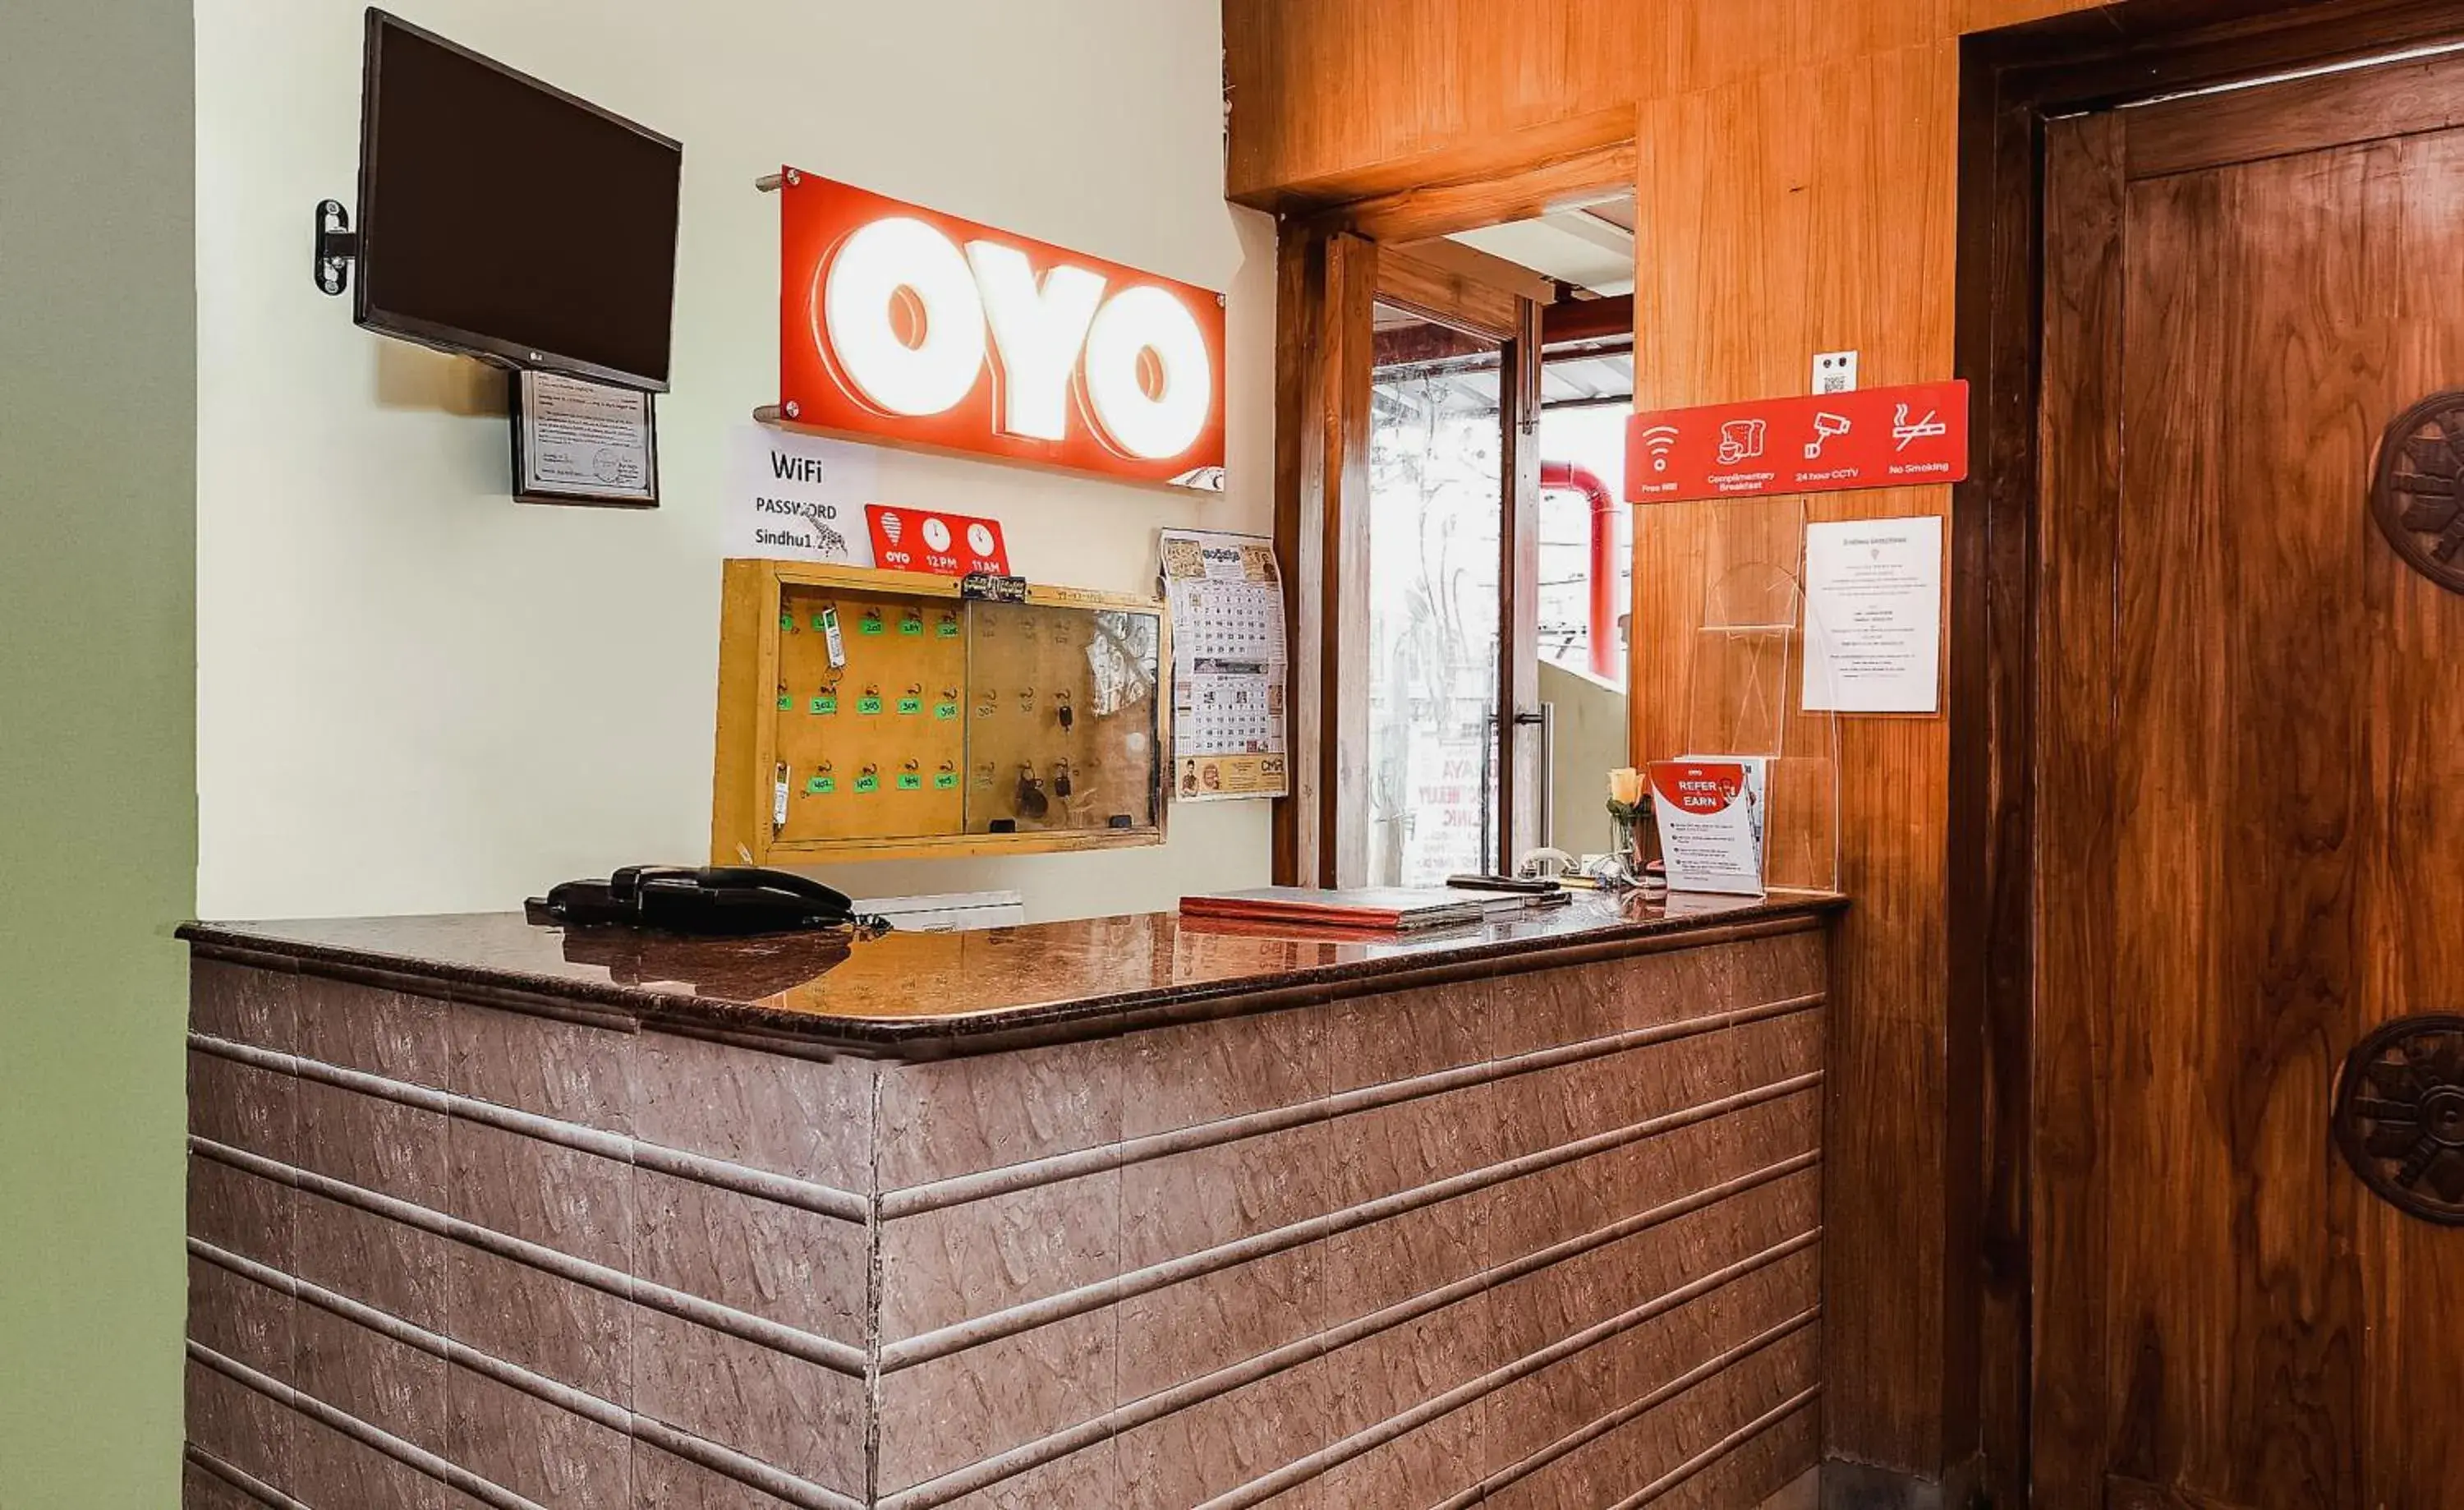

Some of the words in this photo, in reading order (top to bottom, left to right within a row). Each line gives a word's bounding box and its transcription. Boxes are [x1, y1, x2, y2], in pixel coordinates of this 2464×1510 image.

[810, 216, 1211, 460] OYO
[771, 450, 821, 483] WiFi
[1889, 466, 1903, 474] No
[1905, 463, 1949, 473] Smoking
[1832, 469, 1859, 479] CCTV
[756, 497, 837, 519] PASSWORD
[885, 550, 911, 564] OYO
[940, 556, 958, 569] PM
[1679, 780, 1717, 792] REFER
[1684, 796, 1717, 808] EARN
